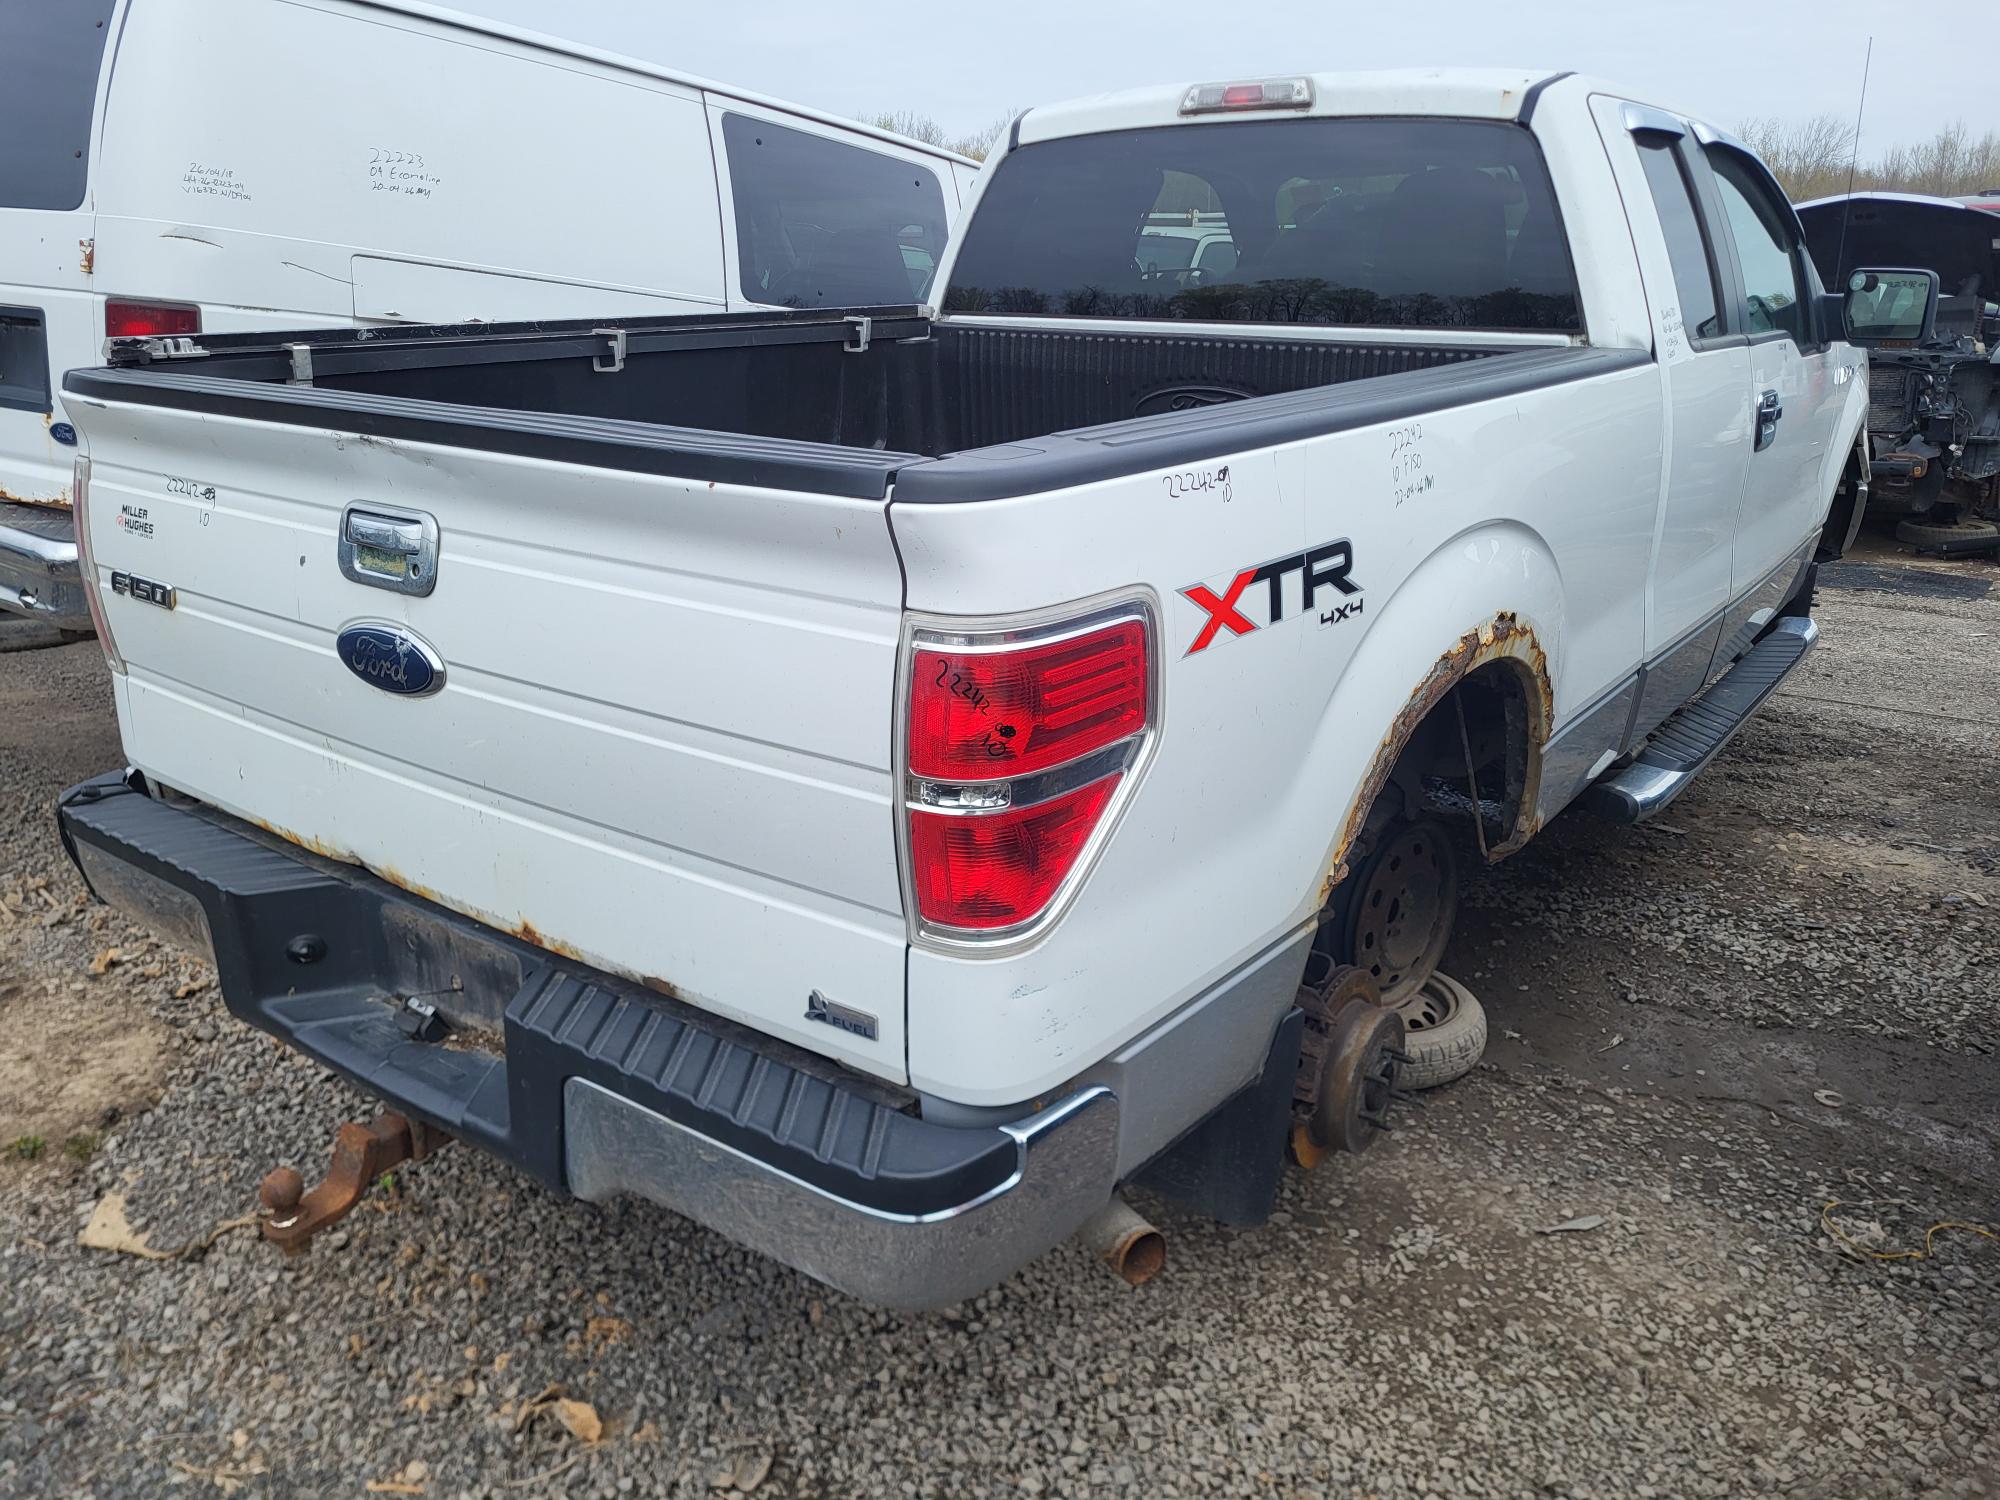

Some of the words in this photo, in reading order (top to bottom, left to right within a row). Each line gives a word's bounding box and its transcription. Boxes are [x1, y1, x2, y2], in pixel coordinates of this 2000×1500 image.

[369, 147, 425, 168] 22223
[1388, 423, 1423, 460] 22242
[121, 504, 148, 520] MILLER
[199, 508, 210, 527] 10
[124, 517, 154, 534] HUGHES
[1176, 536, 1364, 660] XTR
[352, 636, 408, 683] Ford
[936, 659, 990, 717] 22242
[832, 1016, 874, 1040] FUEL
